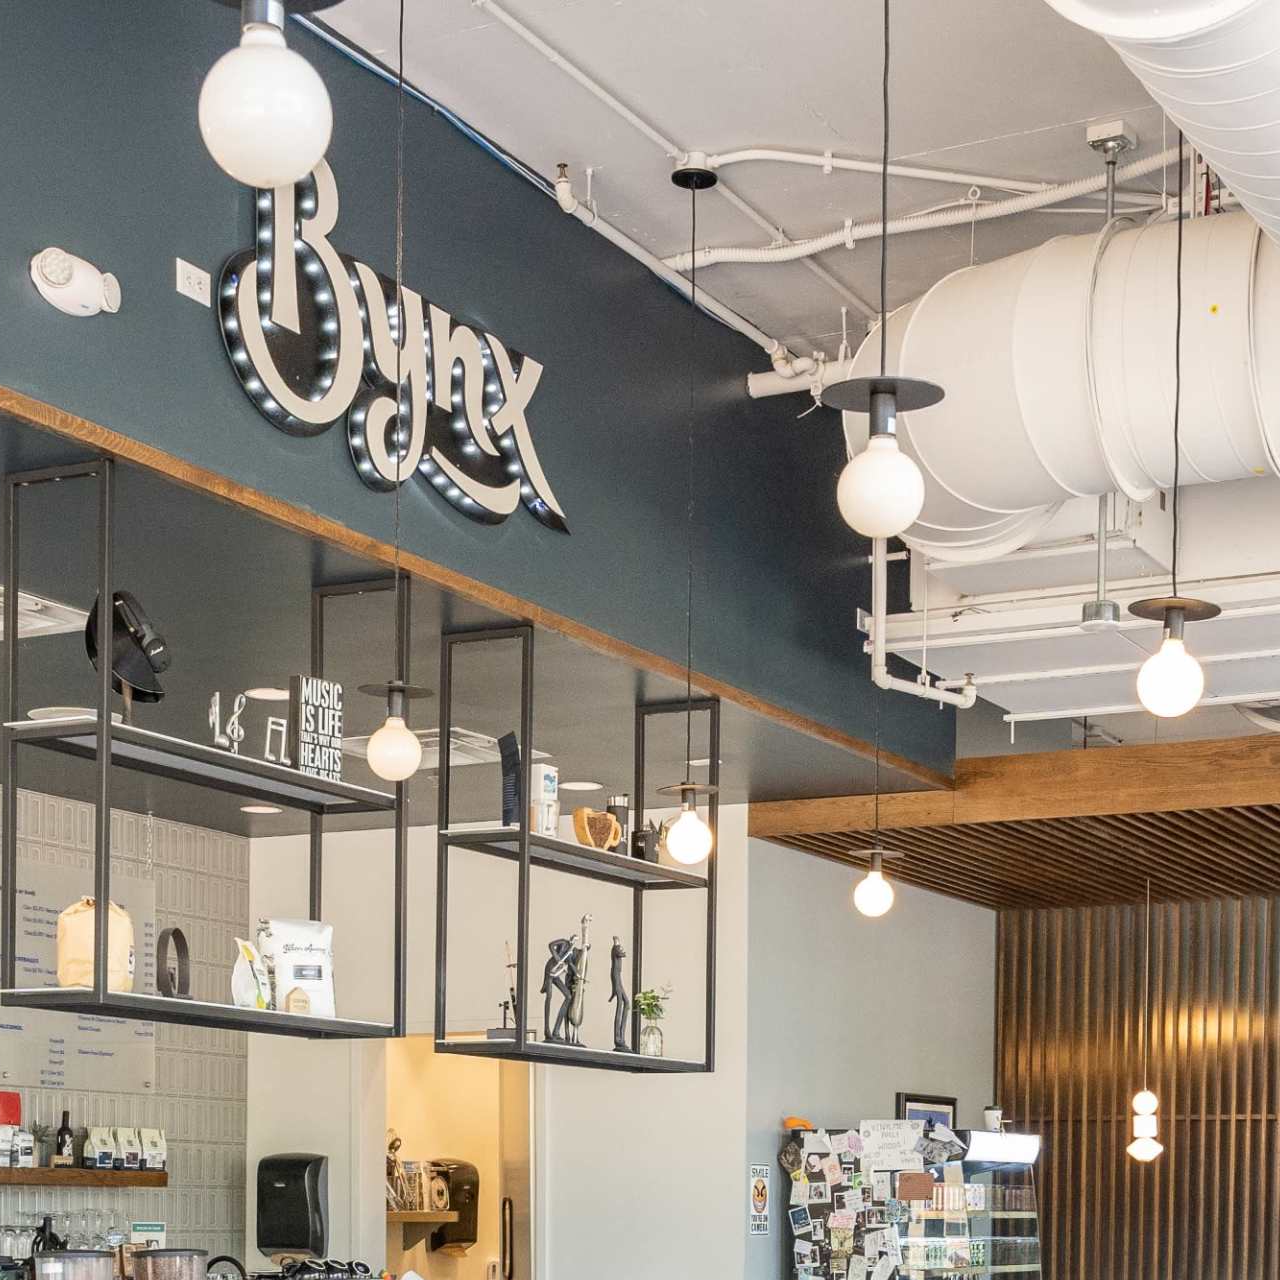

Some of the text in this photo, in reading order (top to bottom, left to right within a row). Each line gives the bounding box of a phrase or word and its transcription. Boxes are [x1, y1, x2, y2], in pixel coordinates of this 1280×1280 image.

[230, 158, 568, 525] Bynx
[302, 676, 343, 710] MUSIC
[301, 704, 343, 738] IS LIFE
[300, 742, 341, 772] HEARTS
